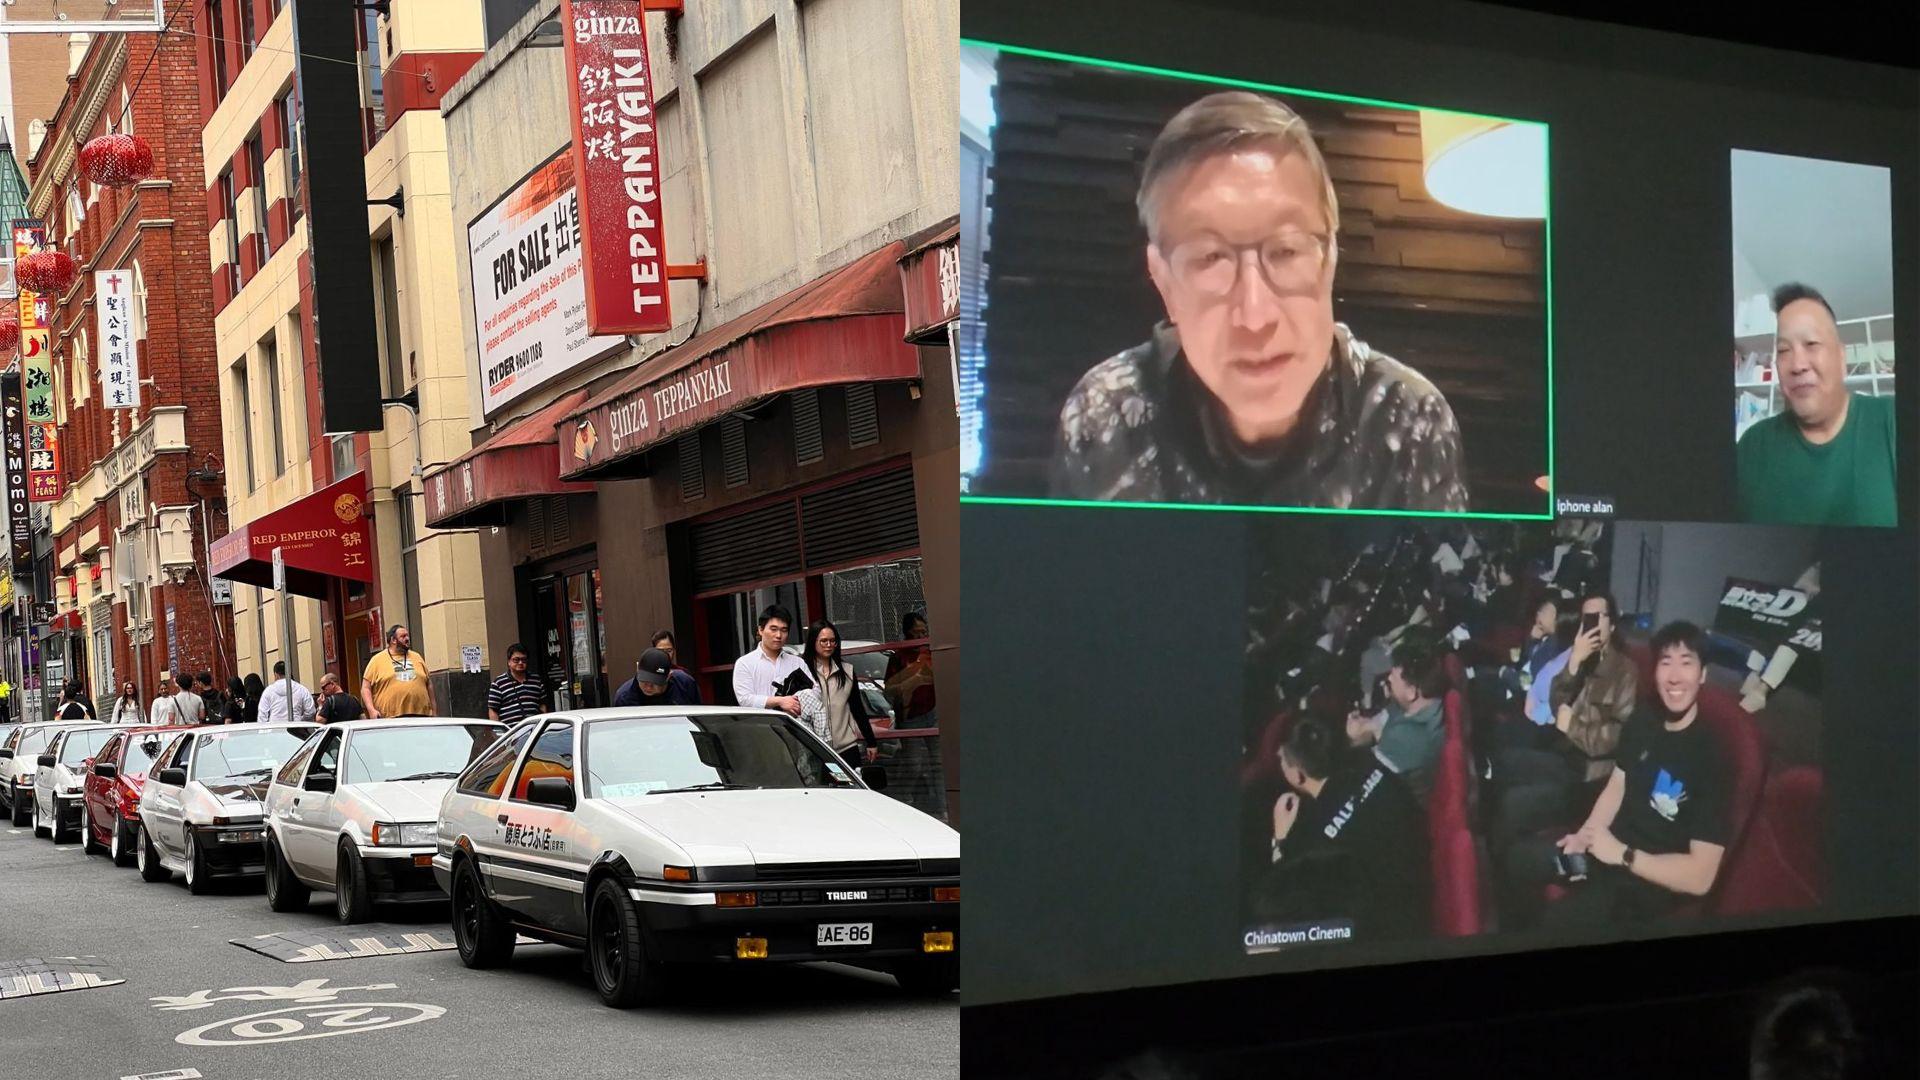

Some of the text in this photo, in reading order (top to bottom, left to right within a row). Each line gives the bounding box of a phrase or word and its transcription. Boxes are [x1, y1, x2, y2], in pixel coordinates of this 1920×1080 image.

[575, 10, 642, 43] ginza
[613, 49, 662, 314] TEPPANYAKI
[493, 223, 551, 300] FOR SALE
[498, 302, 518, 322] enquiries
[518, 287, 540, 310] regarding
[540, 280, 549, 295] the
[549, 273, 561, 290] Sale
[561, 267, 567, 282] of
[566, 262, 578, 279] this
[486, 298, 557, 354] please contact the selling agents
[489, 355, 515, 387] RYDER
[610, 361, 732, 452] ginza TEPPANYAKI
[35, 487, 57, 496] FEAST
[1592, 500, 1614, 513] alan
[252, 528, 337, 545] RED EMPEROR
[341, 531, 365, 566] 錦江
[826, 890, 868, 900] TRUENO
[823, 926, 870, 942] AE-86
[1244, 926, 1351, 946] Chinatown Cinema
